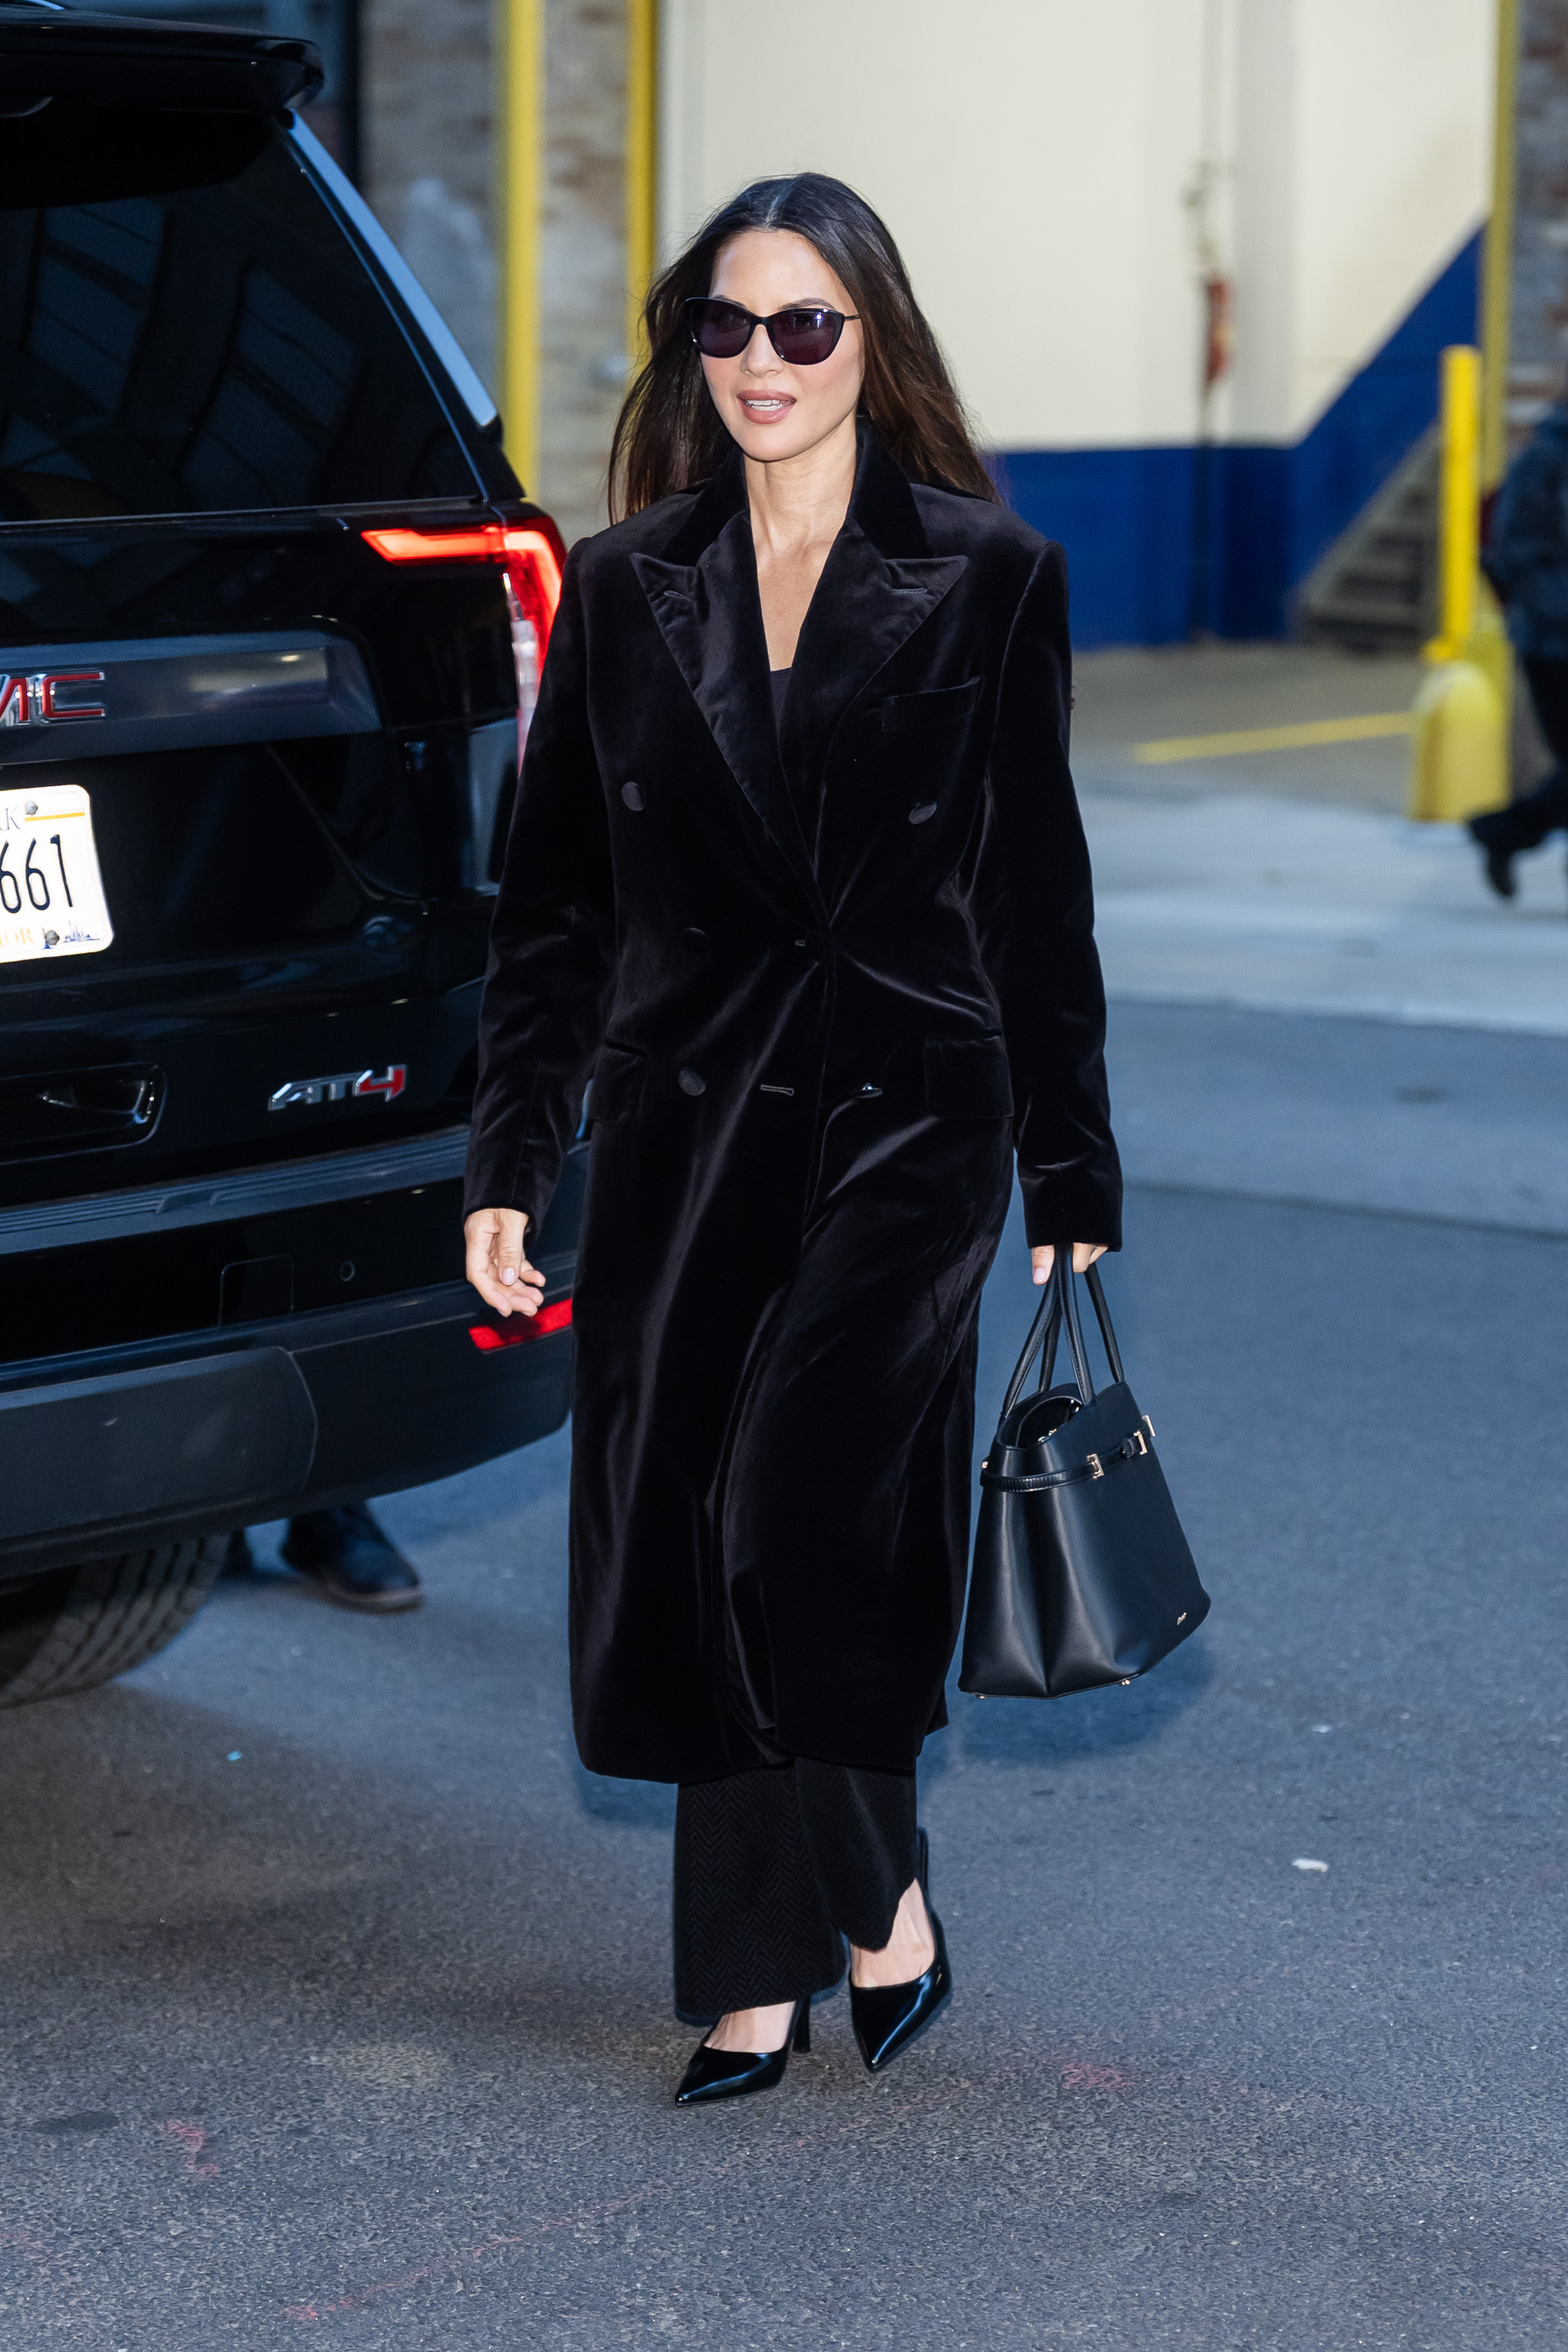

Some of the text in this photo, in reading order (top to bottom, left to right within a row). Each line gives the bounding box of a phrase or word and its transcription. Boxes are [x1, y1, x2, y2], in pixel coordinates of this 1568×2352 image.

[0, 806, 21, 831] K
[0, 834, 73, 914] 661
[268, 1064, 407, 1110] AT4
